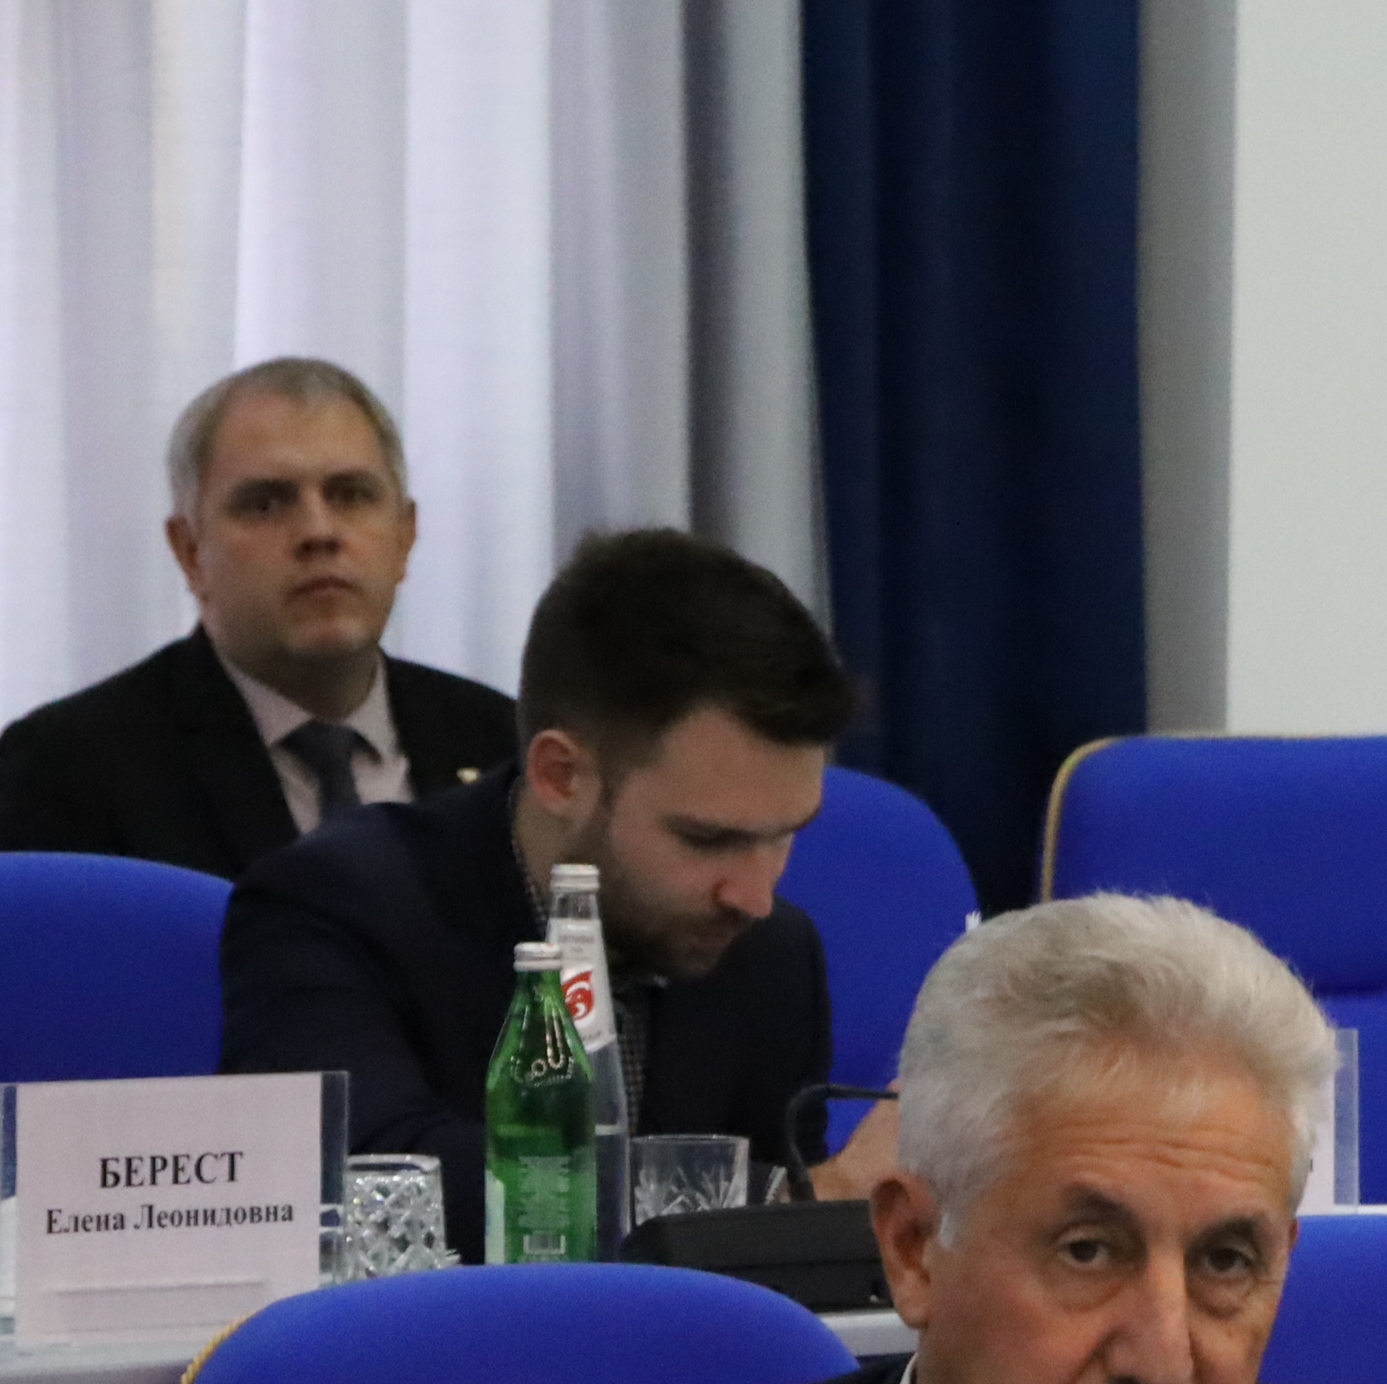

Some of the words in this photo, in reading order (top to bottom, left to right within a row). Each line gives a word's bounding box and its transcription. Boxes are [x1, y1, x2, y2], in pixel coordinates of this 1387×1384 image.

[99, 1151, 243, 1189] БЕРЕСТ
[46, 1207, 126, 1234] Елена
[133, 1203, 295, 1230] Леонидовна
